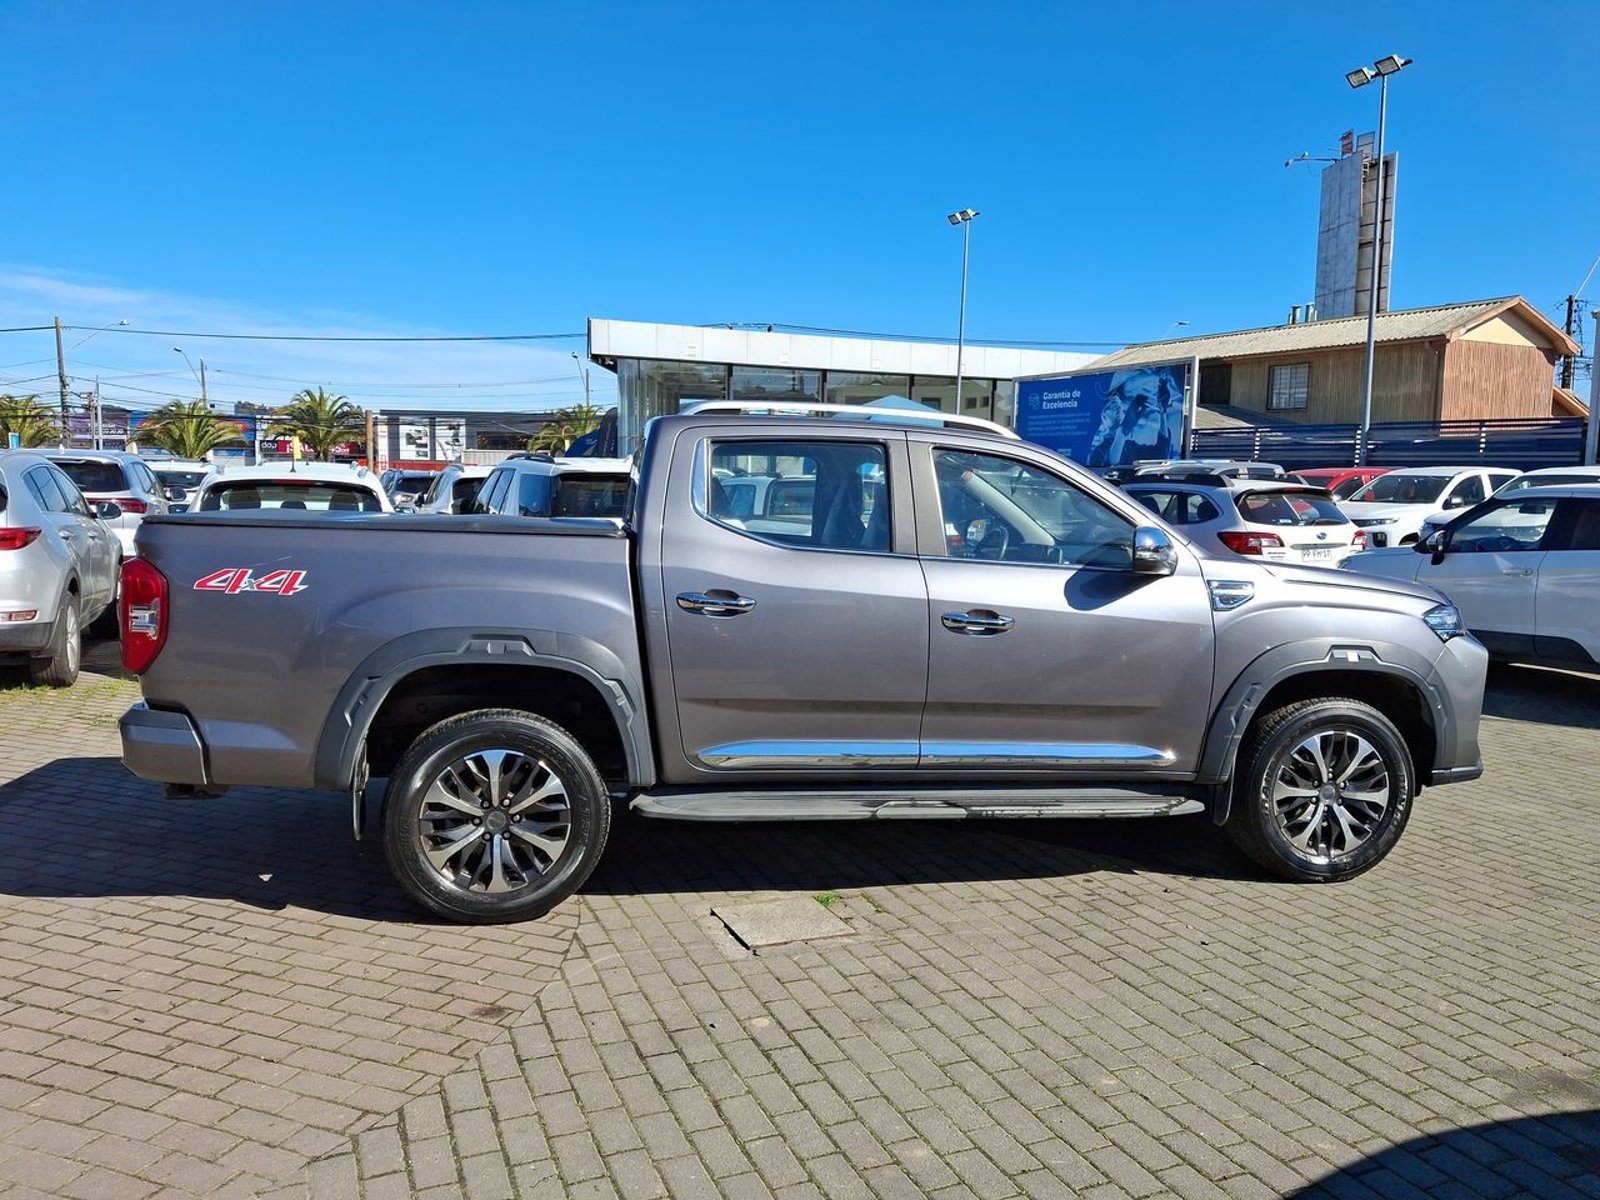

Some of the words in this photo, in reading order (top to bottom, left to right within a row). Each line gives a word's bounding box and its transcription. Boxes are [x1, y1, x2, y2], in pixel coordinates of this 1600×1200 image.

[1072, 389, 1081, 399] de
[1042, 399, 1078, 410] Excelencia
[193, 568, 308, 595] 4x4
